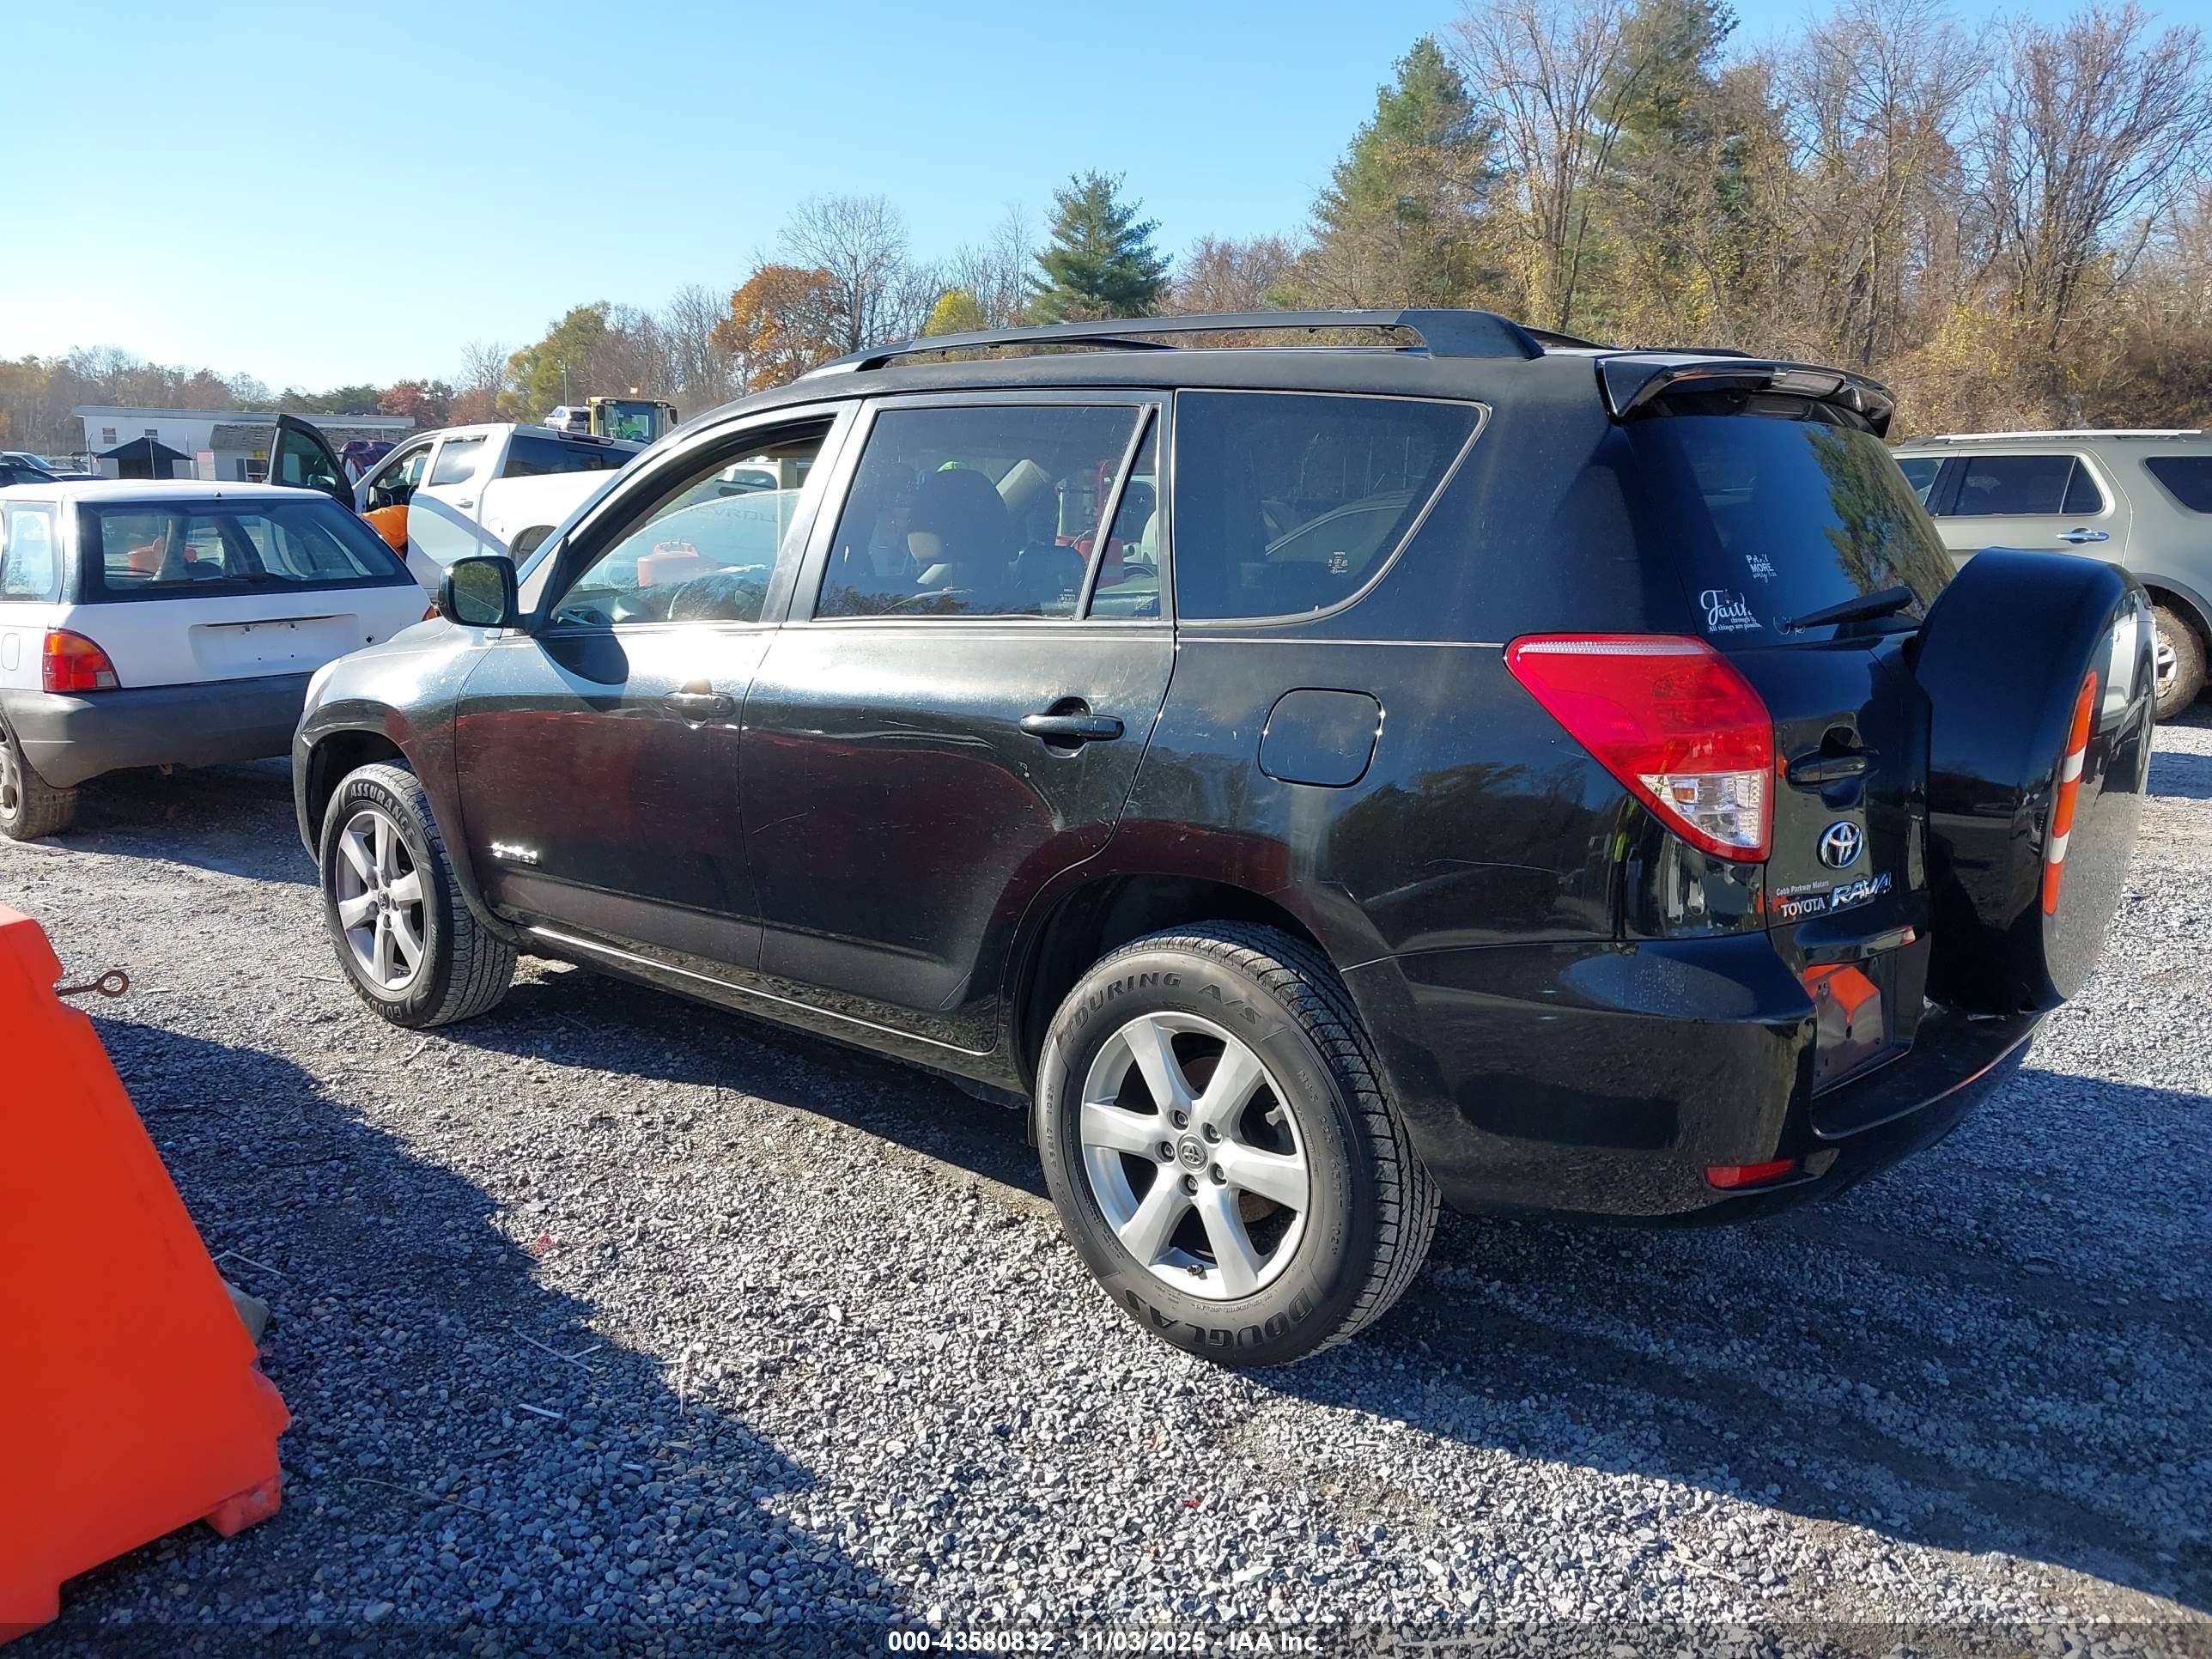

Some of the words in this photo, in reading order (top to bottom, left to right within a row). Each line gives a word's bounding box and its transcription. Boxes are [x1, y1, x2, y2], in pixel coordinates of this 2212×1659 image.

[1749, 562, 1775, 573] MORE
[349, 782, 416, 838] ASSURANCE
[1780, 897, 1826, 917] TOYOTA
[1063, 971, 1182, 1044] TOURING
[1198, 983, 1263, 1024] A/S
[1120, 1287, 1314, 1348] DOUGLAS
